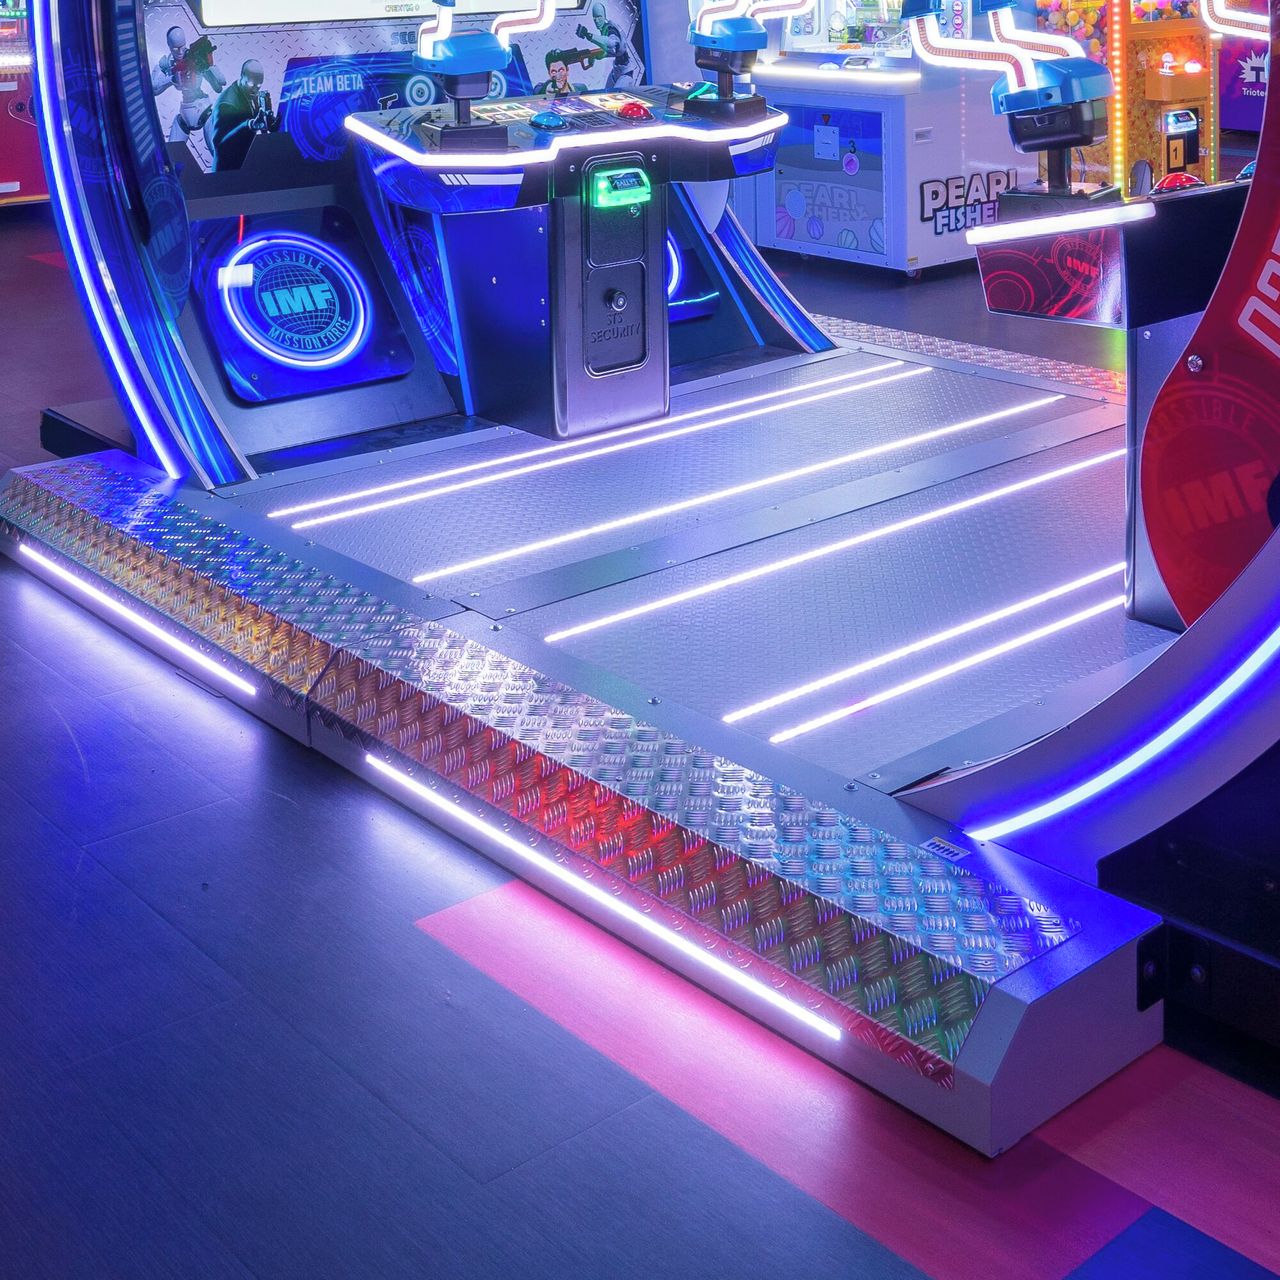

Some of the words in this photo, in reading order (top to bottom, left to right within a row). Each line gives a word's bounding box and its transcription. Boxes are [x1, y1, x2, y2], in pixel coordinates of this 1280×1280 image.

[390, 30, 417, 46] SEG
[302, 76, 333, 94] TEAM
[336, 73, 364, 92] BETA
[1242, 87, 1267, 97] Triote
[847, 140, 857, 154] 3
[1172, 146, 1179, 161] 1
[261, 283, 333, 317] IMF
[267, 326, 322, 350] MISSION
[323, 316, 351, 346] FORCE
[590, 323, 642, 344] SECURITY
